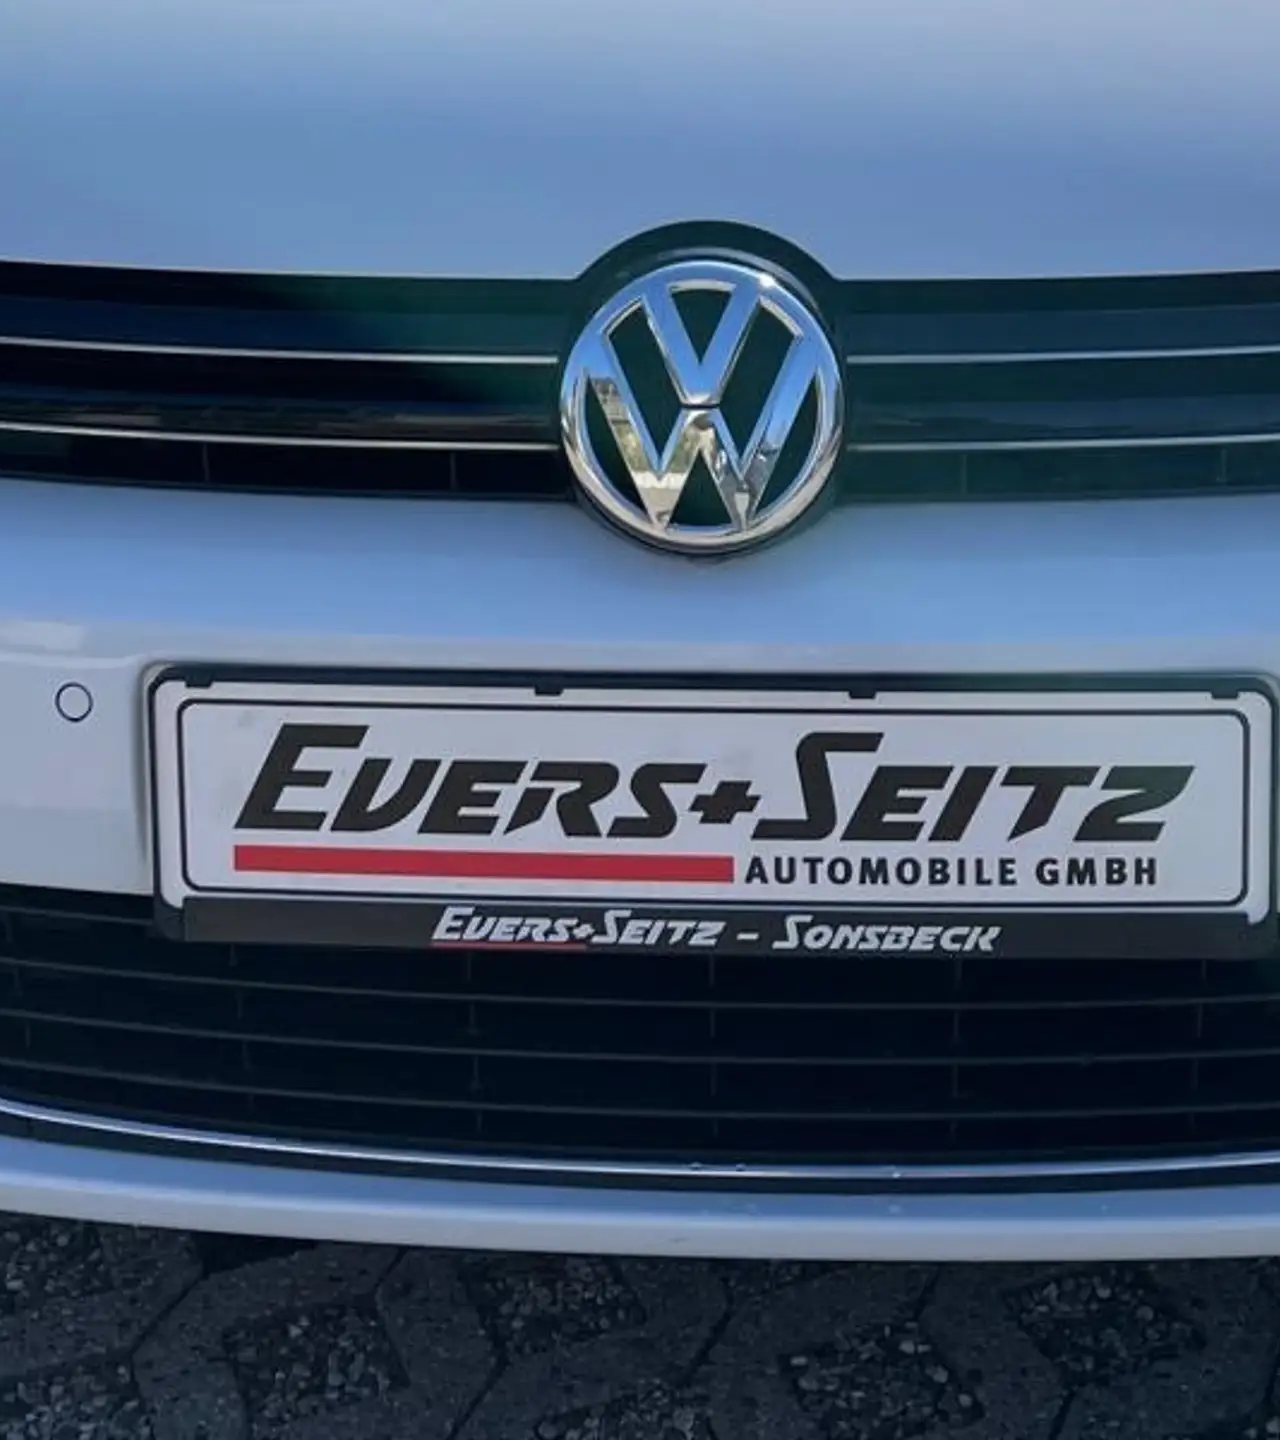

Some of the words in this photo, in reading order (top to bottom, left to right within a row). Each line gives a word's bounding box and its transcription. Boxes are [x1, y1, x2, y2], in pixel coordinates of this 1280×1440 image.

[745, 857, 1018, 887] AUTOMOBILE
[1035, 857, 1159, 888] GMBH
[772, 914, 1002, 951] SONSBECK
